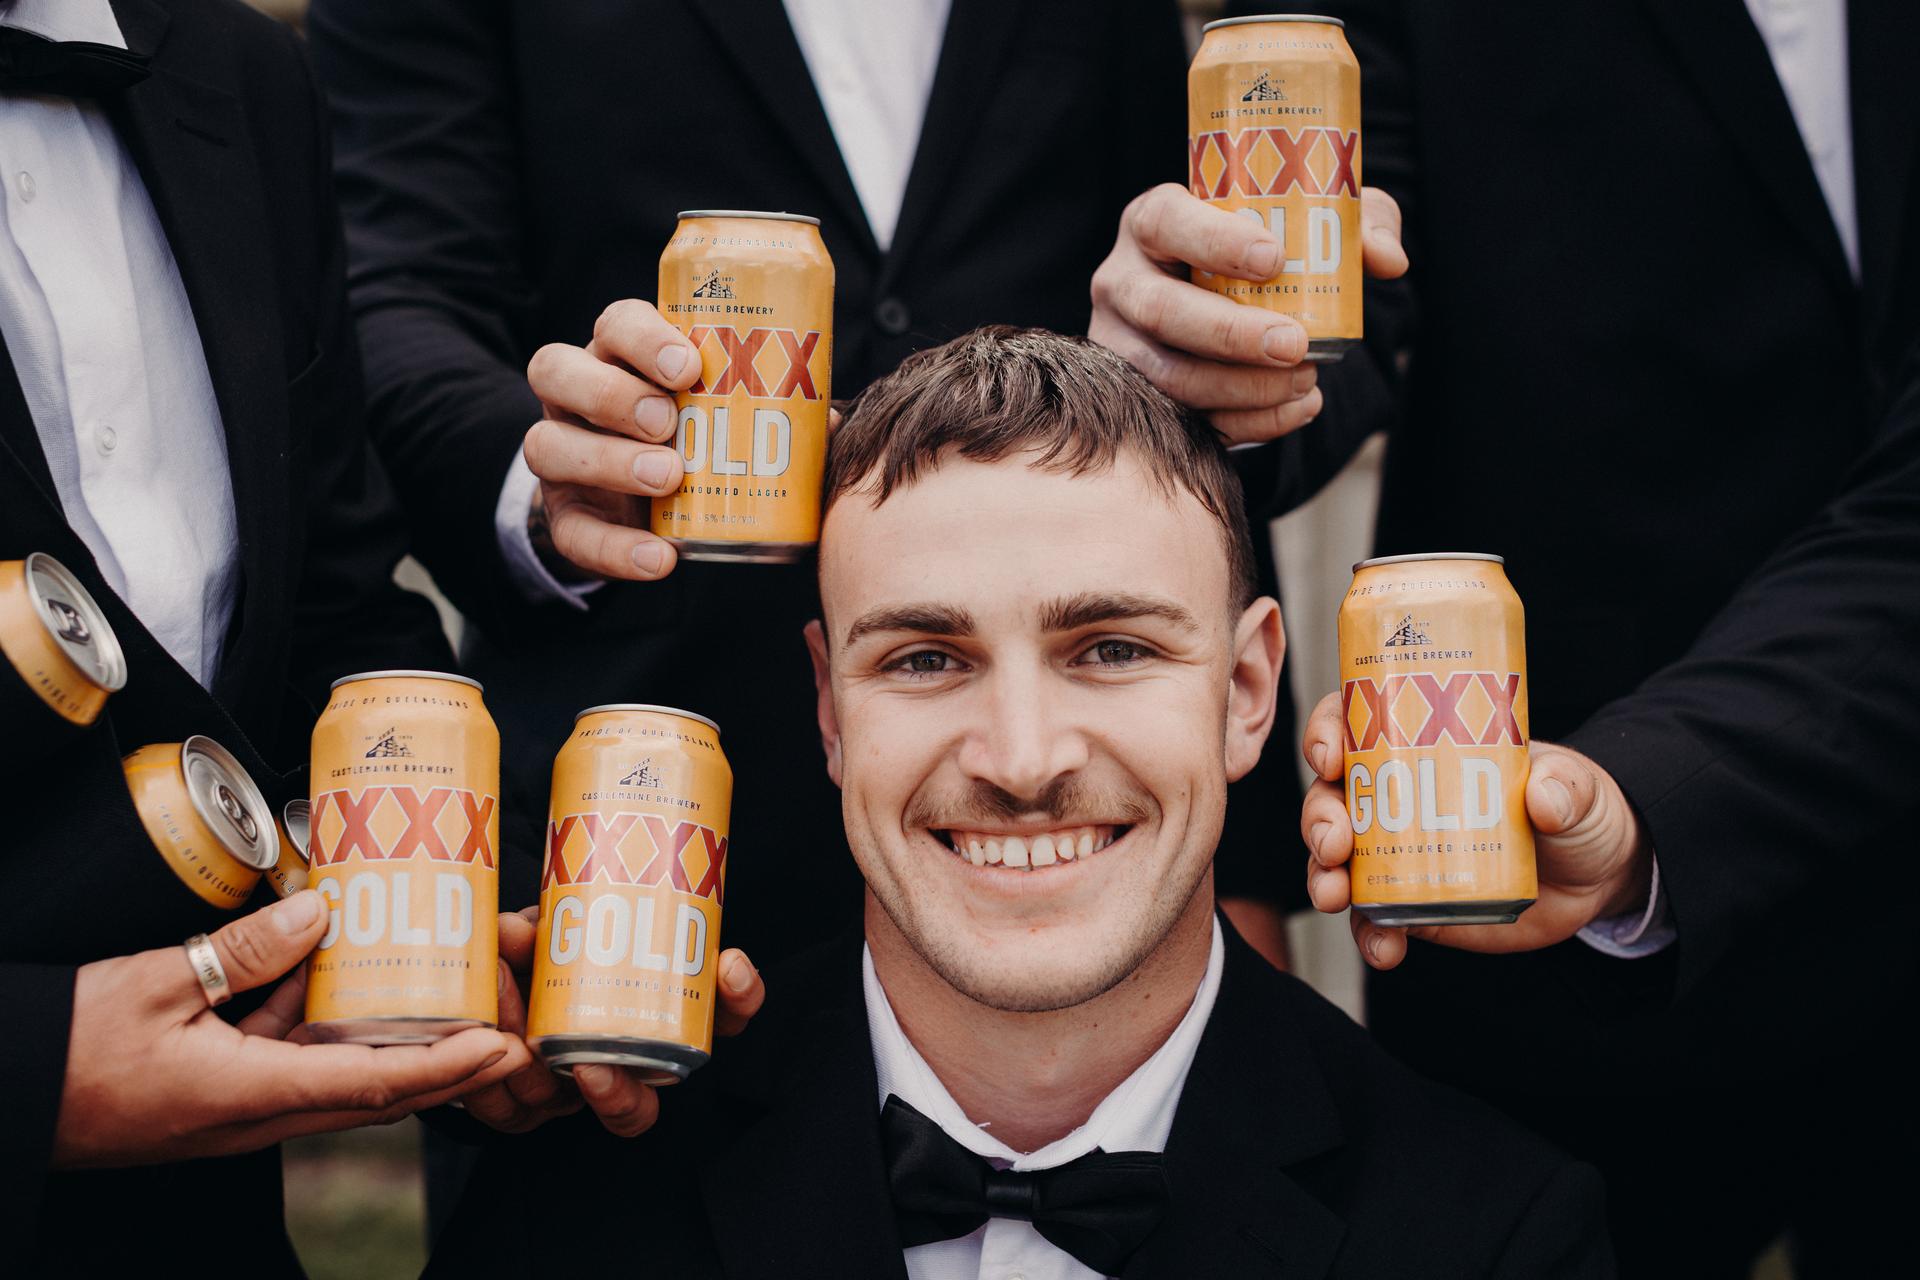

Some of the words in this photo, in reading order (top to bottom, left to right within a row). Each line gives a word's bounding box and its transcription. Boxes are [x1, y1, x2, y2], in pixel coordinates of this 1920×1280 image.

[1210, 108, 1273, 119] CASTLEMAINE
[1278, 107, 1323, 115] BREWERY
[1225, 286, 1299, 295] FLAVOURED
[667, 304, 721, 313] CASTLEMAINE
[726, 306, 775, 315] BREWERY
[675, 405, 791, 477] OLD
[677, 485, 739, 496] LAVOURED
[748, 487, 787, 498] LAGER
[1355, 652, 1417, 666] CASTLEMAINE
[1423, 650, 1473, 660] BREWERY
[579, 727, 610, 738] PRIDE
[618, 727, 632, 735] OF
[642, 728, 716, 751] QUEENSLAND
[331, 764, 398, 778] CASTLEMAINE
[404, 764, 454, 775] BREWERY
[582, 792, 651, 801] CASTLEMAINE
[656, 795, 701, 811] BREWERY
[1349, 757, 1502, 835] GOLD
[1376, 843, 1453, 856] FLAVOURED
[1463, 842, 1503, 852] LAGER
[316, 870, 473, 950] GOLD
[549, 893, 707, 977] GOLD
[546, 978, 572, 988] FULL
[668, 986, 700, 1000] LAGER
